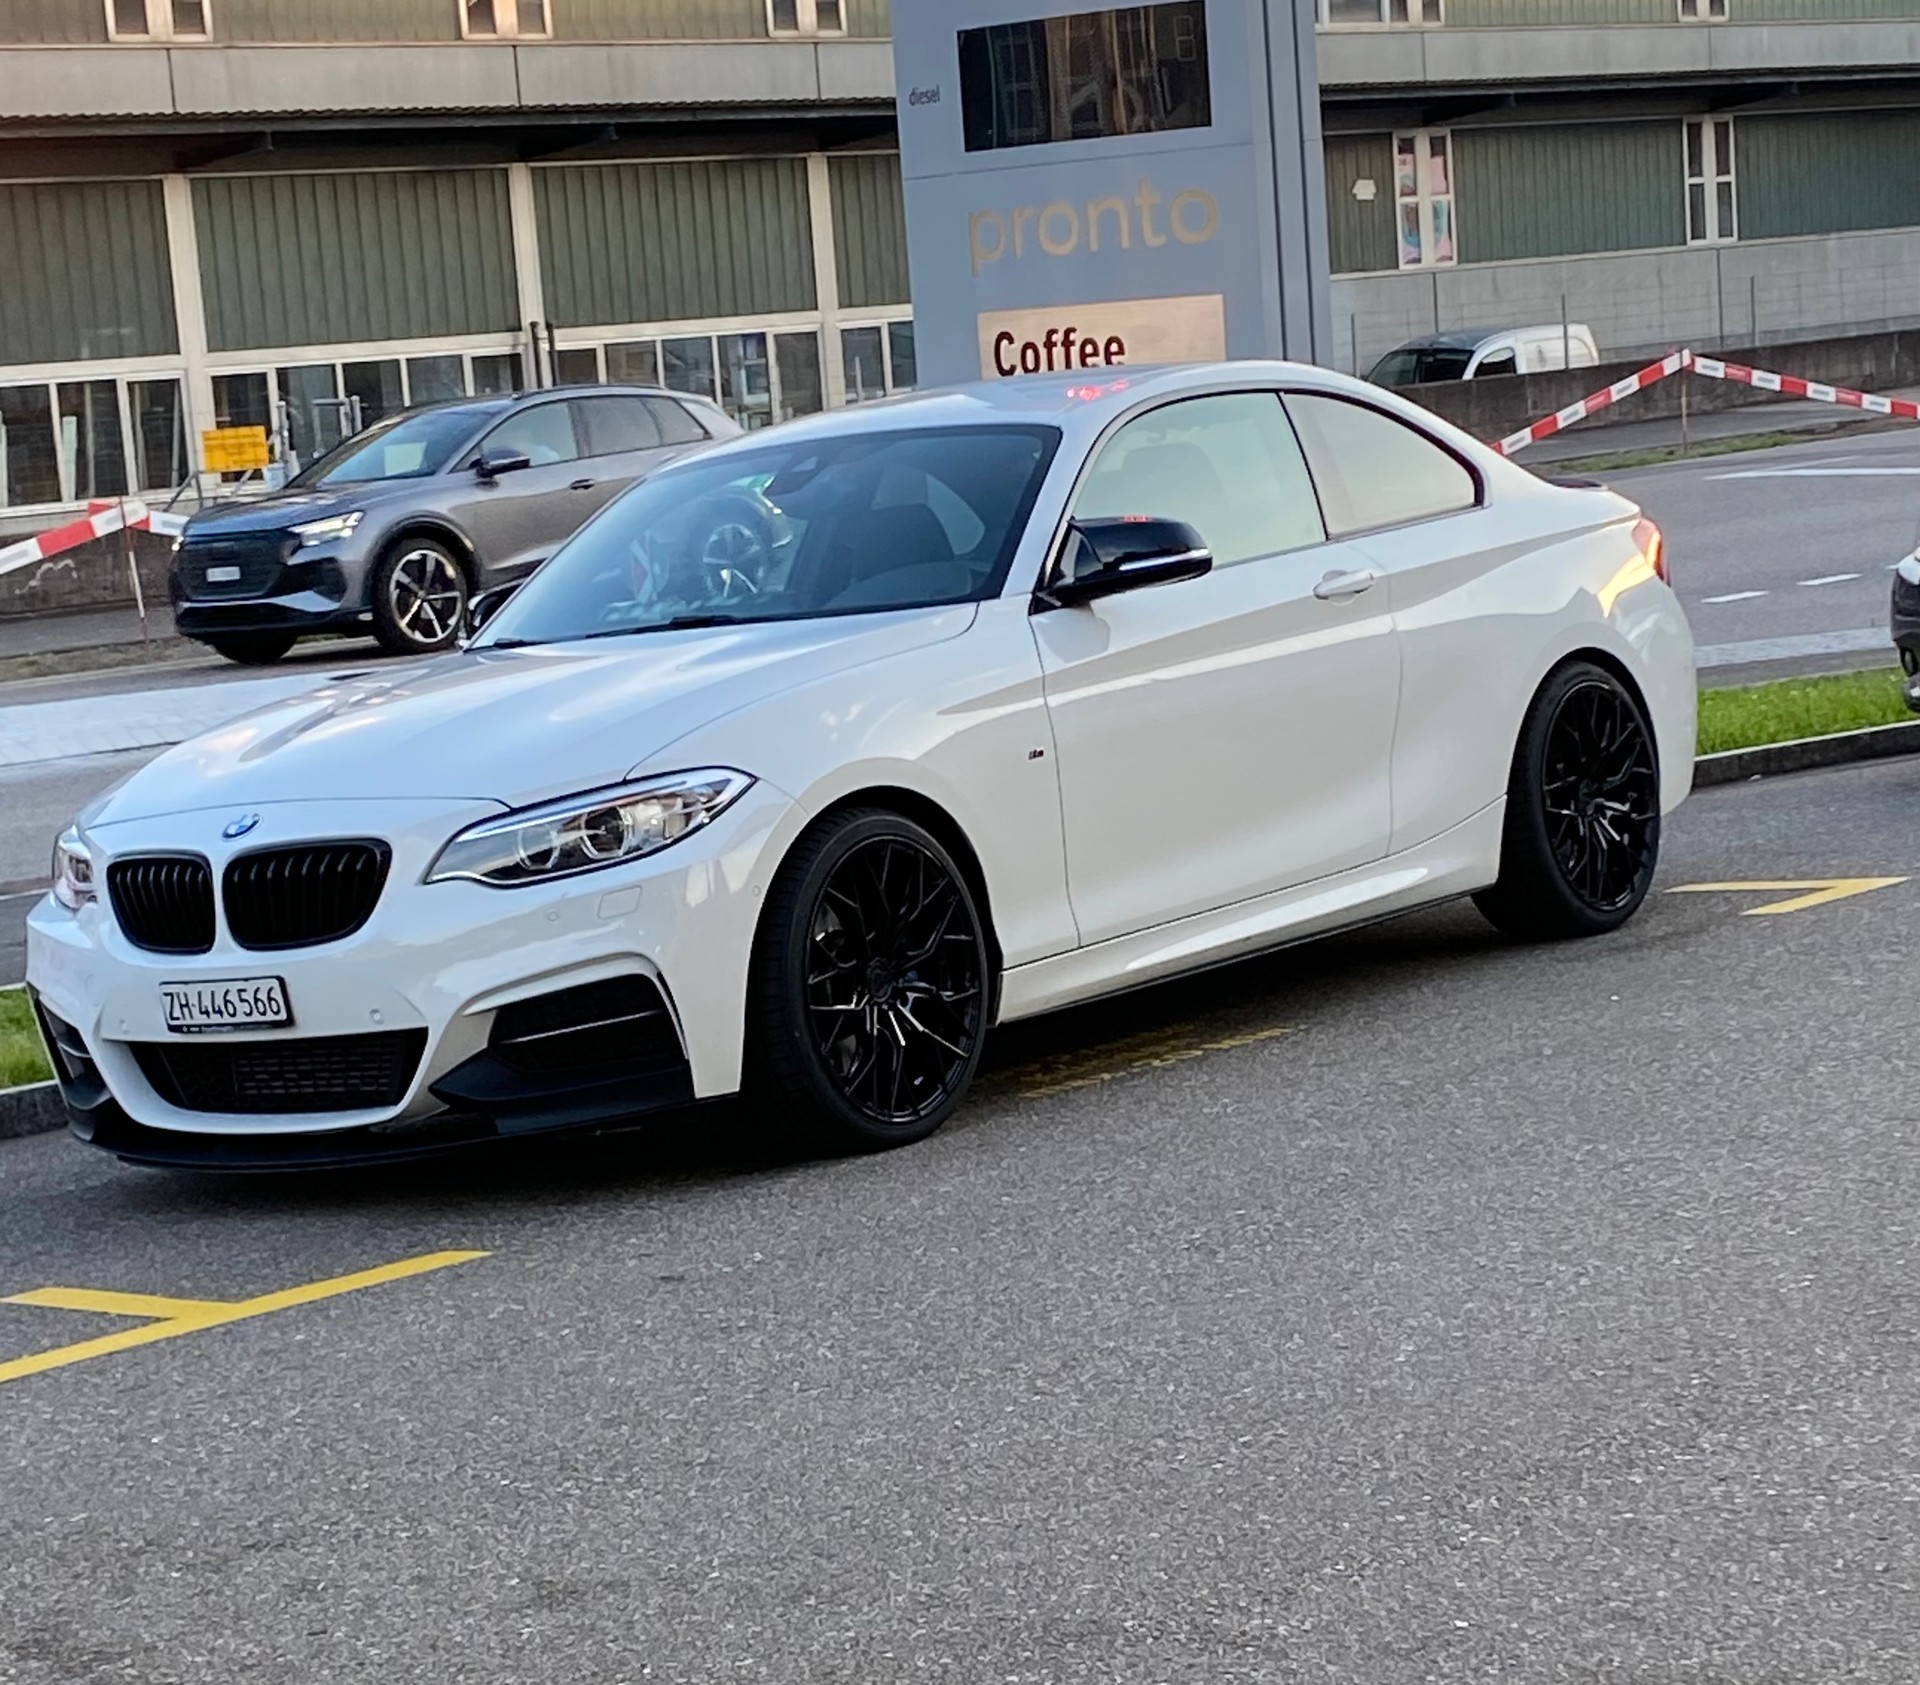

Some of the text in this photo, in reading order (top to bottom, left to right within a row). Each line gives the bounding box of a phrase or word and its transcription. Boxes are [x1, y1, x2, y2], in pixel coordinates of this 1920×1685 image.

[909, 85, 940, 106] diesel
[968, 177, 1220, 277] pronto
[994, 327, 1126, 377] Coffee
